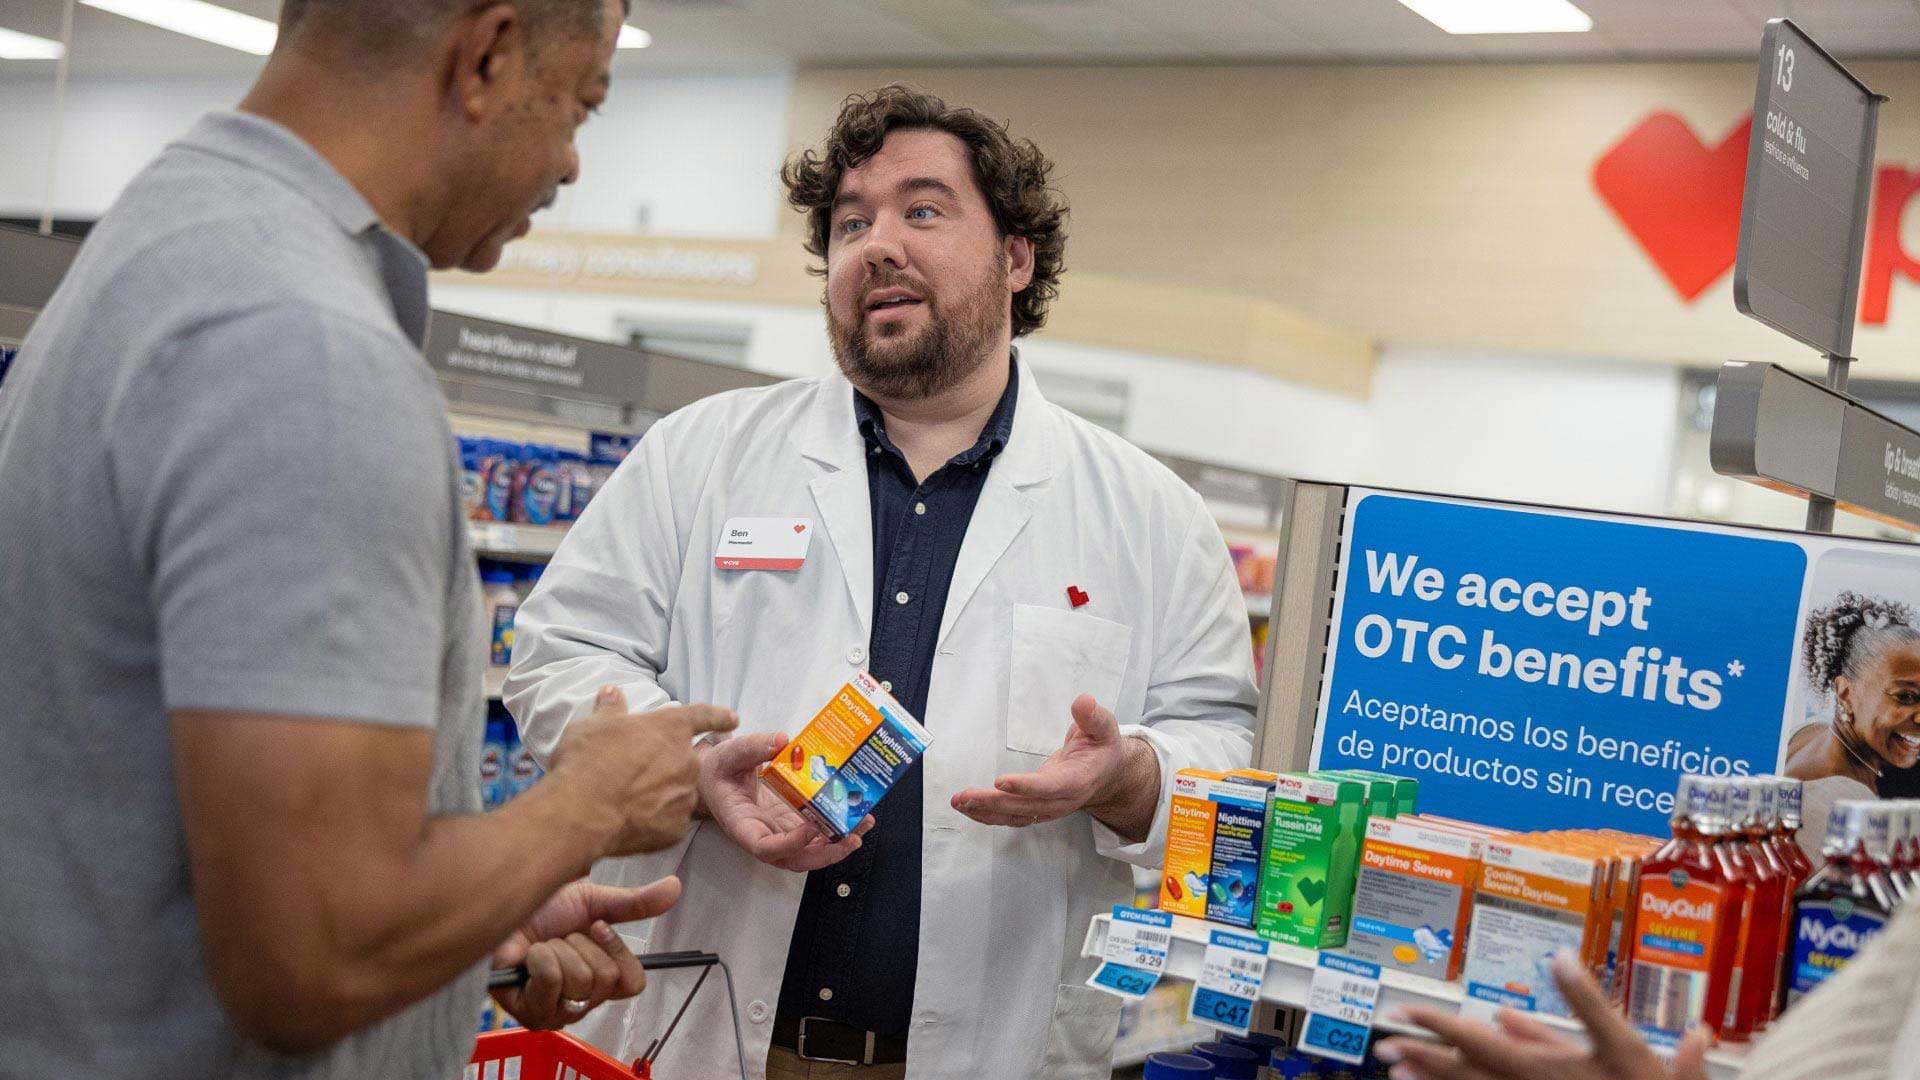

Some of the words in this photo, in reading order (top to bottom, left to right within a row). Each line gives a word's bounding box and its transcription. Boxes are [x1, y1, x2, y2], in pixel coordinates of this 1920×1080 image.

[1777, 44, 1795, 92] 13
[1766, 111, 1787, 139] cold
[1786, 121, 1795, 146] &
[1794, 126, 1807, 154] flu
[1884, 442, 1895, 476] lip
[1894, 447, 1902, 474] &
[731, 529, 748, 537] Ben
[1364, 549, 1445, 602] We
[1456, 573, 1652, 635] accept
[1353, 613, 1467, 670] OTC
[838, 693, 874, 726] Daytime
[875, 727, 915, 764] Nighttime
[1342, 689, 1515, 742] Aceptamos
[1524, 717, 1568, 751] los
[1576, 723, 1751, 778] beneficios
[1182, 780, 1197, 788] CVS
[1286, 780, 1303, 789] CVS
[1337, 731, 1374, 760] de
[1381, 739, 1538, 789] productos
[1547, 767, 1592, 800] sin
[1601, 781, 1675, 814] rece
[1173, 805, 1210, 821] Daytime
[1217, 812, 1263, 830] Nighttime
[1273, 816, 1305, 831] Tussin
[1305, 822, 1323, 835] DM
[1376, 823, 1392, 832] CVS
[1364, 850, 1411, 873] Daytime
[1412, 859, 1454, 880] Severe
[1483, 866, 1526, 887] Cooling
[1482, 878, 1522, 896] Severe
[1521, 885, 1569, 907] Daytime
[1119, 910, 1142, 921] OTCH
[1642, 892, 1714, 921] DayQuil
[1216, 934, 1238, 946] OTCH
[1649, 922, 1698, 941] SEVERE
[1799, 915, 1874, 951] NyQui
[1324, 957, 1347, 969] OTCH
[1212, 999, 1251, 1025] C47
[1326, 1028, 1366, 1052] C23
